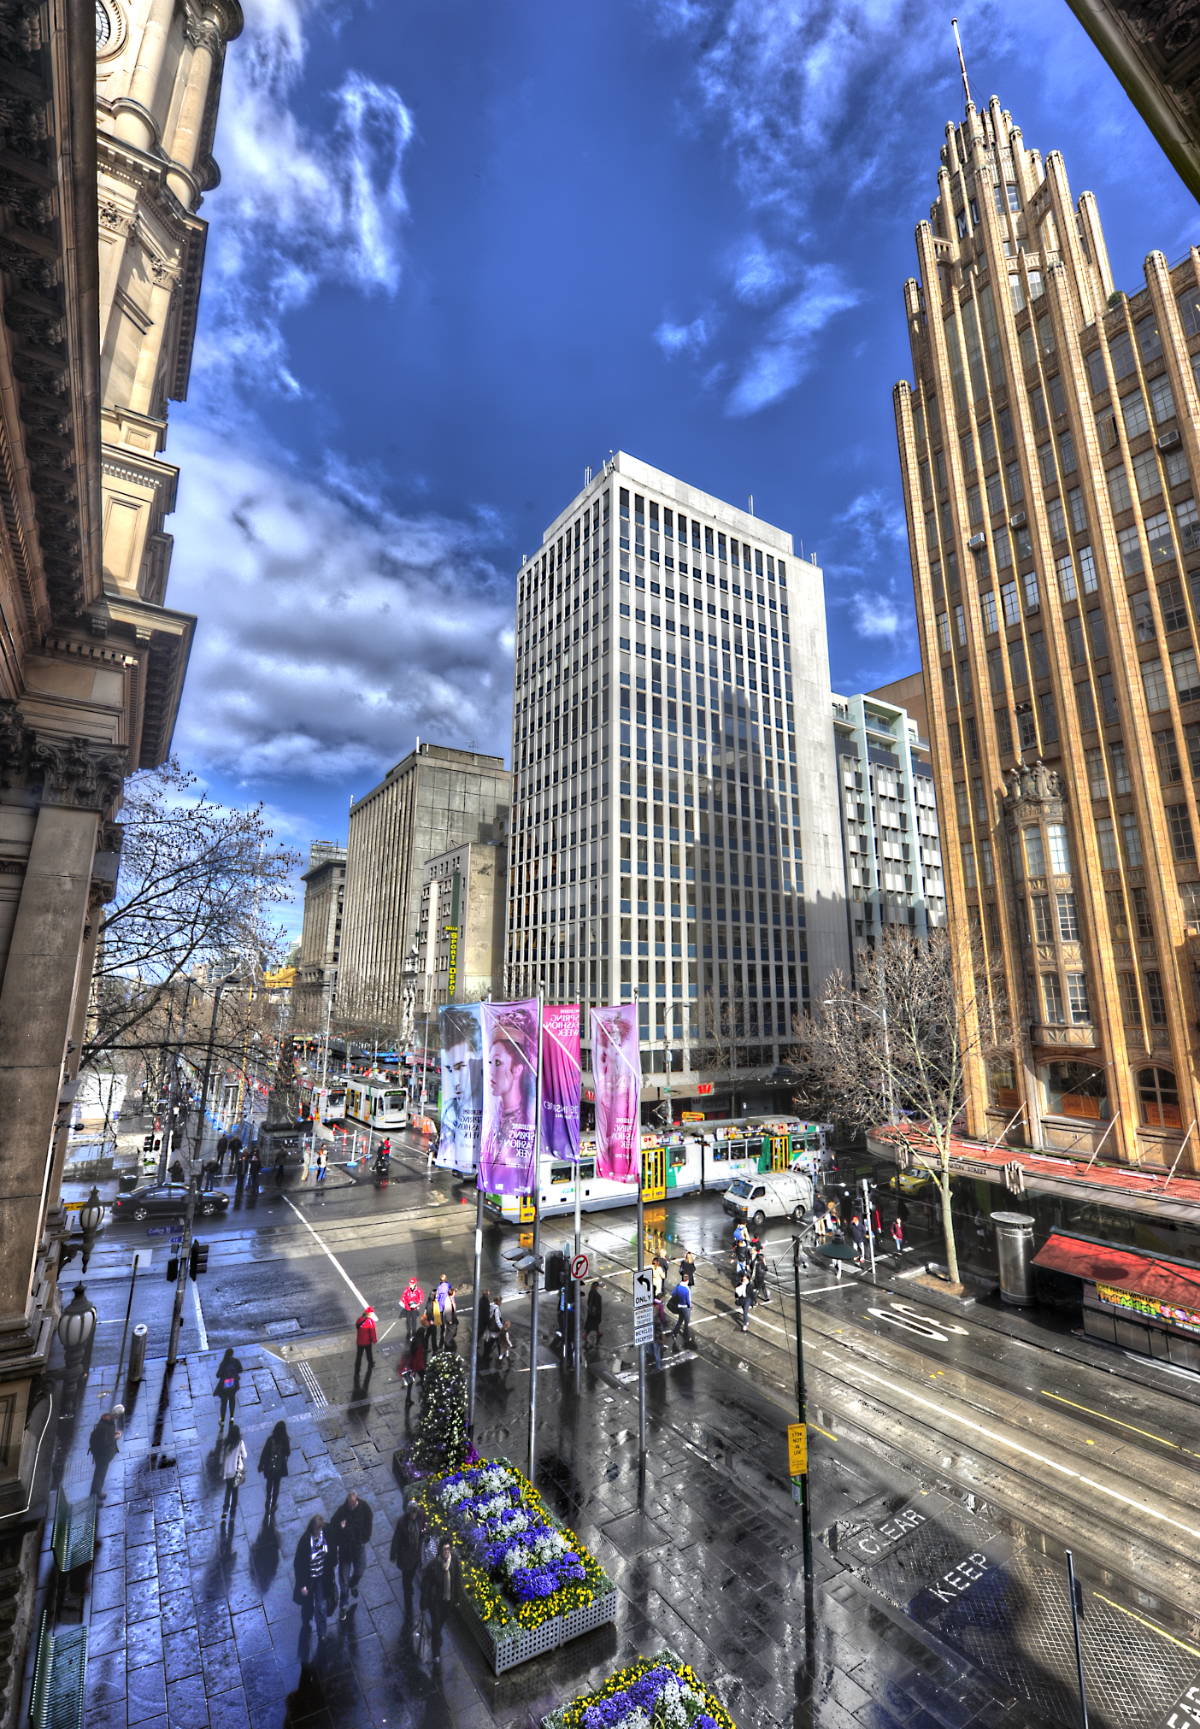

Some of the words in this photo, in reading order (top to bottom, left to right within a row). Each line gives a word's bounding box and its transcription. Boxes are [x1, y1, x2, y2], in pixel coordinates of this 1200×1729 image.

[450, 932, 458, 965] SPORTS
[635, 1295, 651, 1304] ONLY
[859, 1509, 926, 1554] CLEAR
[928, 1553, 988, 1603] KEEP
